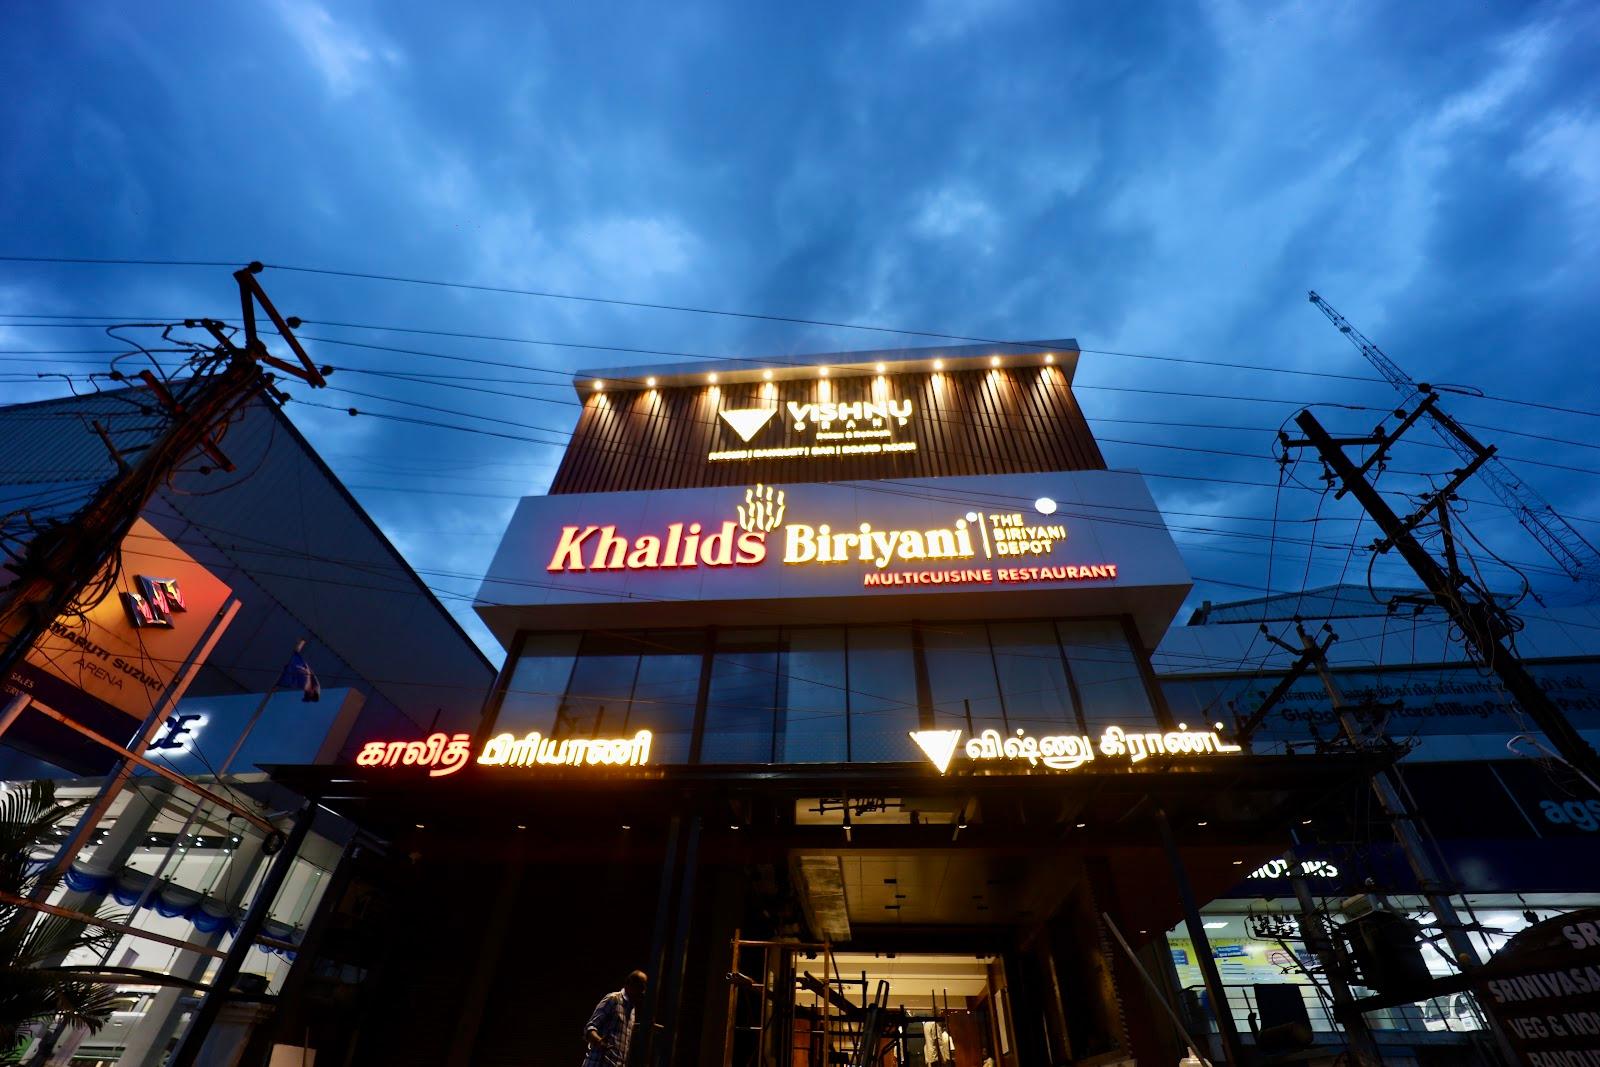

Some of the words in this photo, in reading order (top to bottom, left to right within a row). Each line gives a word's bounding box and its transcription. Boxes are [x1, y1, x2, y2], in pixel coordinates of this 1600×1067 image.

[787, 400, 912, 422] VISHNU
[990, 513, 1023, 527] THE
[993, 525, 1066, 541] BIRIYANI
[547, 521, 767, 572] Khalids
[784, 518, 974, 567] Biriyani
[996, 540, 1053, 555] DEPOT
[863, 568, 993, 587] MULTICUISINE
[997, 564, 1117, 583] RESTAURANT
[51, 622, 112, 662] MARUTI
[112, 657, 163, 692] SUZUKI
[73, 658, 124, 690] ARENA
[356, 732, 471, 777] காலித்
[476, 729, 653, 767] பிரியாணி
[965, 727, 1095, 770] விஷ்ணு
[1099, 722, 1242, 763] கிராண்ட்
[1487, 965, 1600, 1004] SRINIVASA
[1507, 1016, 1549, 1039] VEG
[1547, 1015, 1568, 1036] &
